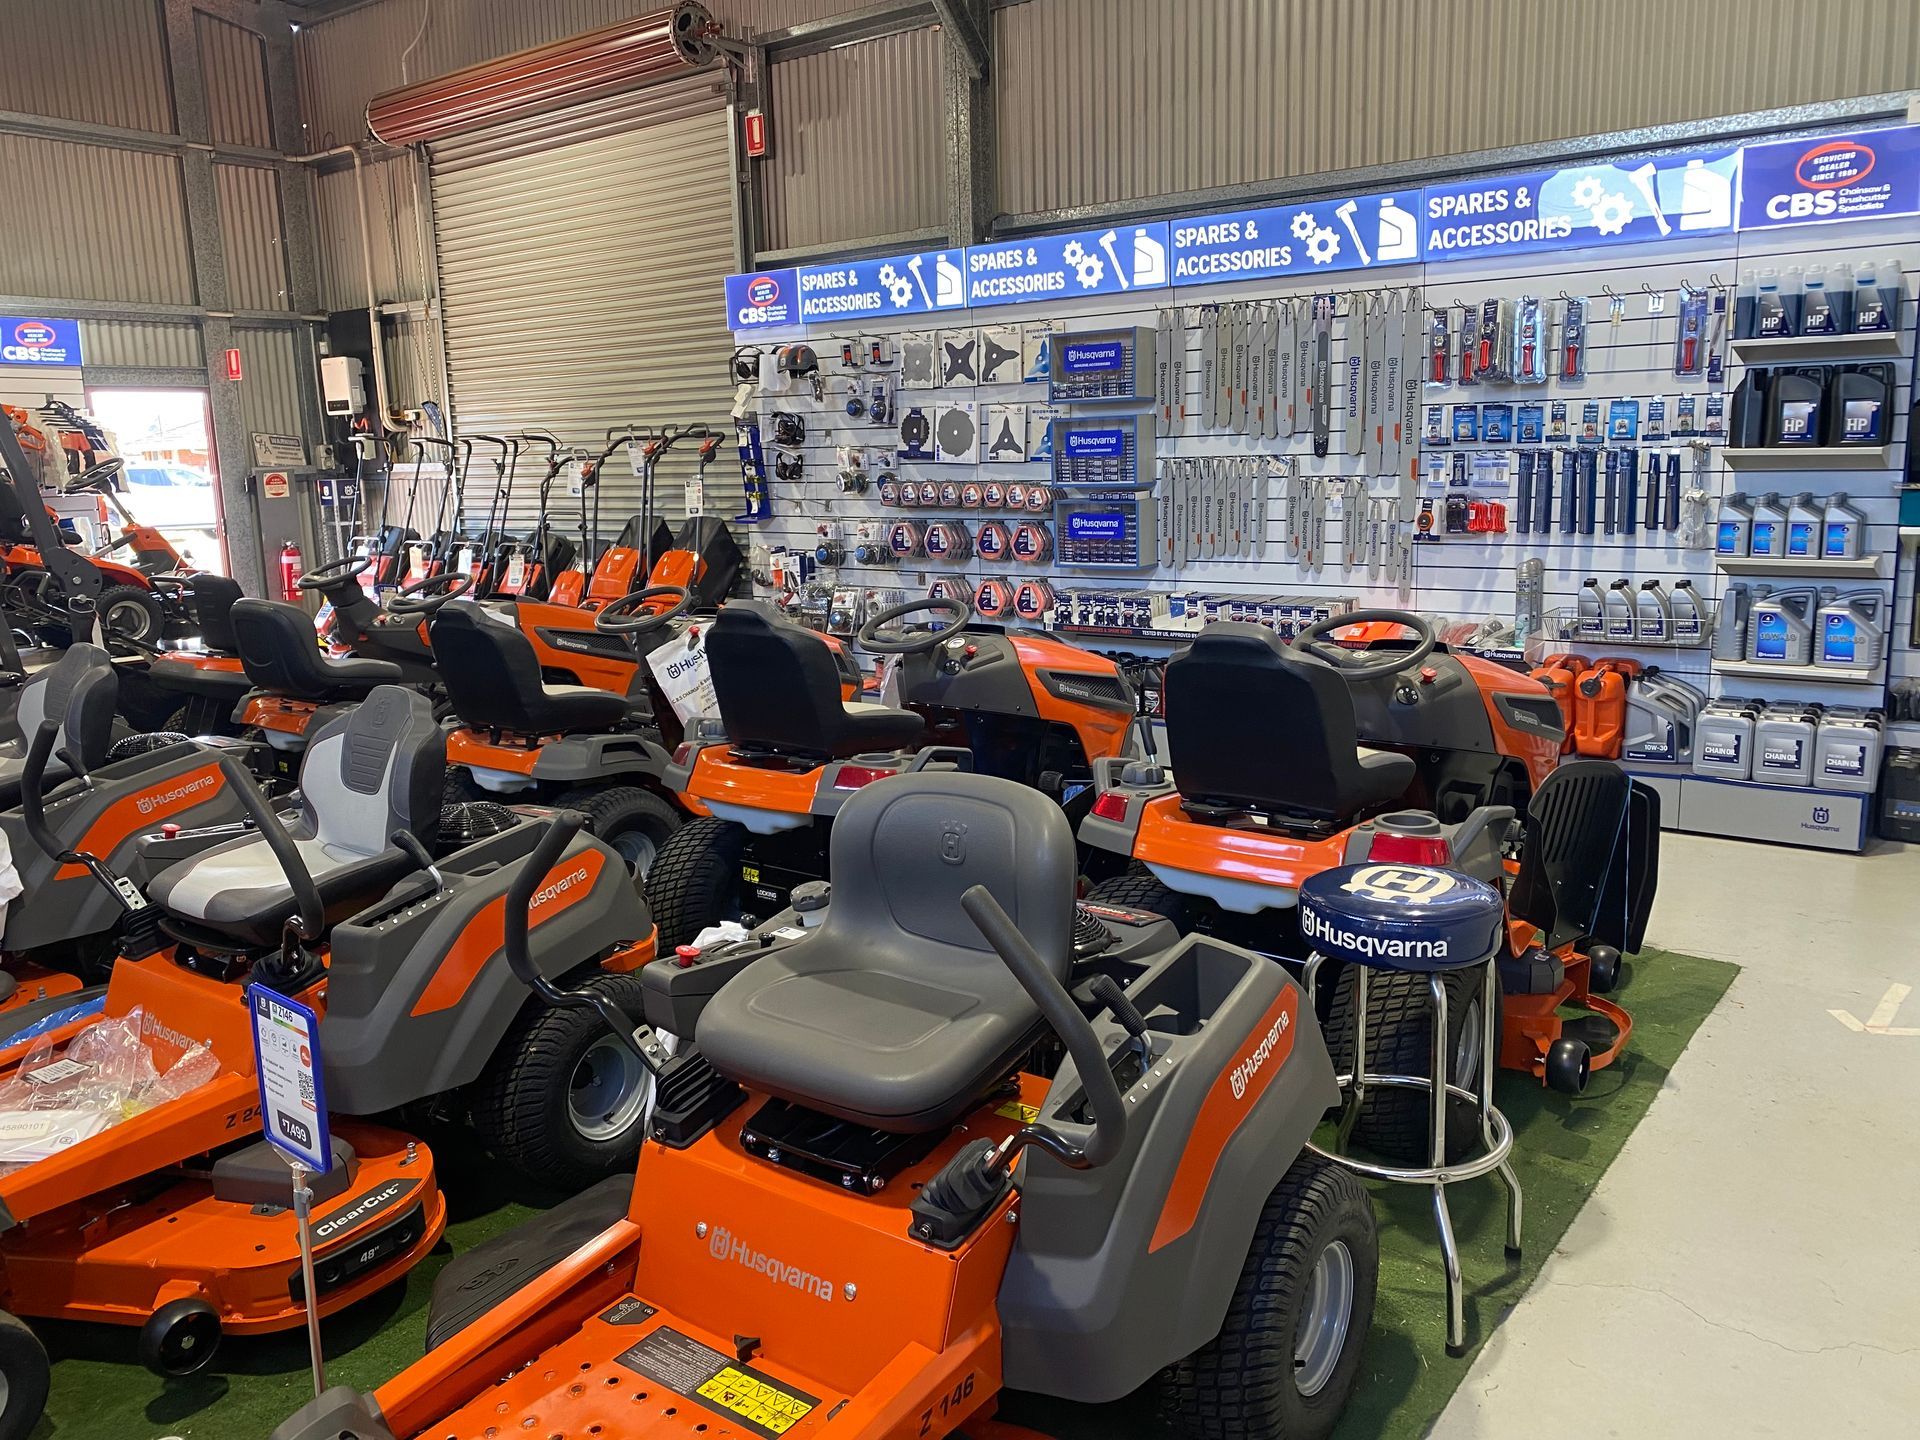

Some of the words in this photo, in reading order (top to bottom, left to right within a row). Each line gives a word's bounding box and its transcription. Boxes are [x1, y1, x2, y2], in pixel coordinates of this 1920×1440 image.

[1813, 152, 1856, 165] SERVICING
[1819, 161, 1850, 172] DEALER
[1811, 171, 1835, 182] SINCE
[1839, 185, 1882, 196] Chainsaw
[1883, 183, 1891, 191] &
[1429, 189, 1509, 219] SPARES
[1514, 186, 1531, 209] &
[1766, 190, 1837, 220] CBS
[1838, 192, 1891, 205] Brushcutter
[1838, 201, 1884, 214] Specialists
[1175, 222, 1240, 249] SPARES
[1244, 220, 1258, 239] &
[1428, 215, 1572, 250] ACCESSORIES
[970, 249, 1022, 273] SPARES
[1026, 247, 1038, 266] &
[1175, 246, 1292, 277] ACCESSORIES
[802, 273, 846, 291] SPARES
[848, 270, 858, 286] &
[971, 271, 1065, 299] ACCESSORIES
[803, 292, 881, 315] ACCESSORIES
[739, 307, 767, 324] CBS
[1762, 317, 1779, 328] HP
[1807, 315, 1825, 326] HP
[1859, 311, 1878, 323] HP
[3, 346, 41, 361] CBS
[1076, 350, 1115, 360] Husqvarna
[1300, 350, 1308, 387] Husqvarna
[1349, 367, 1358, 418] Husqvarna
[1371, 370, 1379, 415] Husqvarna
[1388, 367, 1397, 412] Husqvarna
[1405, 391, 1416, 445] Husqvarna
[1784, 419, 1805, 432] HP
[1846, 418, 1868, 431] HP
[1078, 436, 1116, 446] Husqvarna
[1080, 519, 1118, 528] Husqvarna
[1490, 651, 1521, 659] Husqvarna
[1644, 744, 1668, 752] 10W-30
[1705, 746, 1726, 755] CHAIN
[1764, 752, 1786, 761] CHAIN
[1826, 758, 1849, 767] CHAIN
[151, 774, 215, 808] Husqvarna
[1801, 822, 1840, 833] Husqvarna
[529, 868, 588, 910] usqvarna
[1316, 916, 1448, 958] Husqvarna
[278, 1006, 294, 1023] Z146
[1241, 1010, 1290, 1084] Husqvarna
[225, 1114, 238, 1129] Z
[282, 1118, 307, 1143] $7,499
[729, 1240, 834, 1302] Husqvarna
[919, 1407, 933, 1437] Z
[940, 1372, 975, 1417] 146
